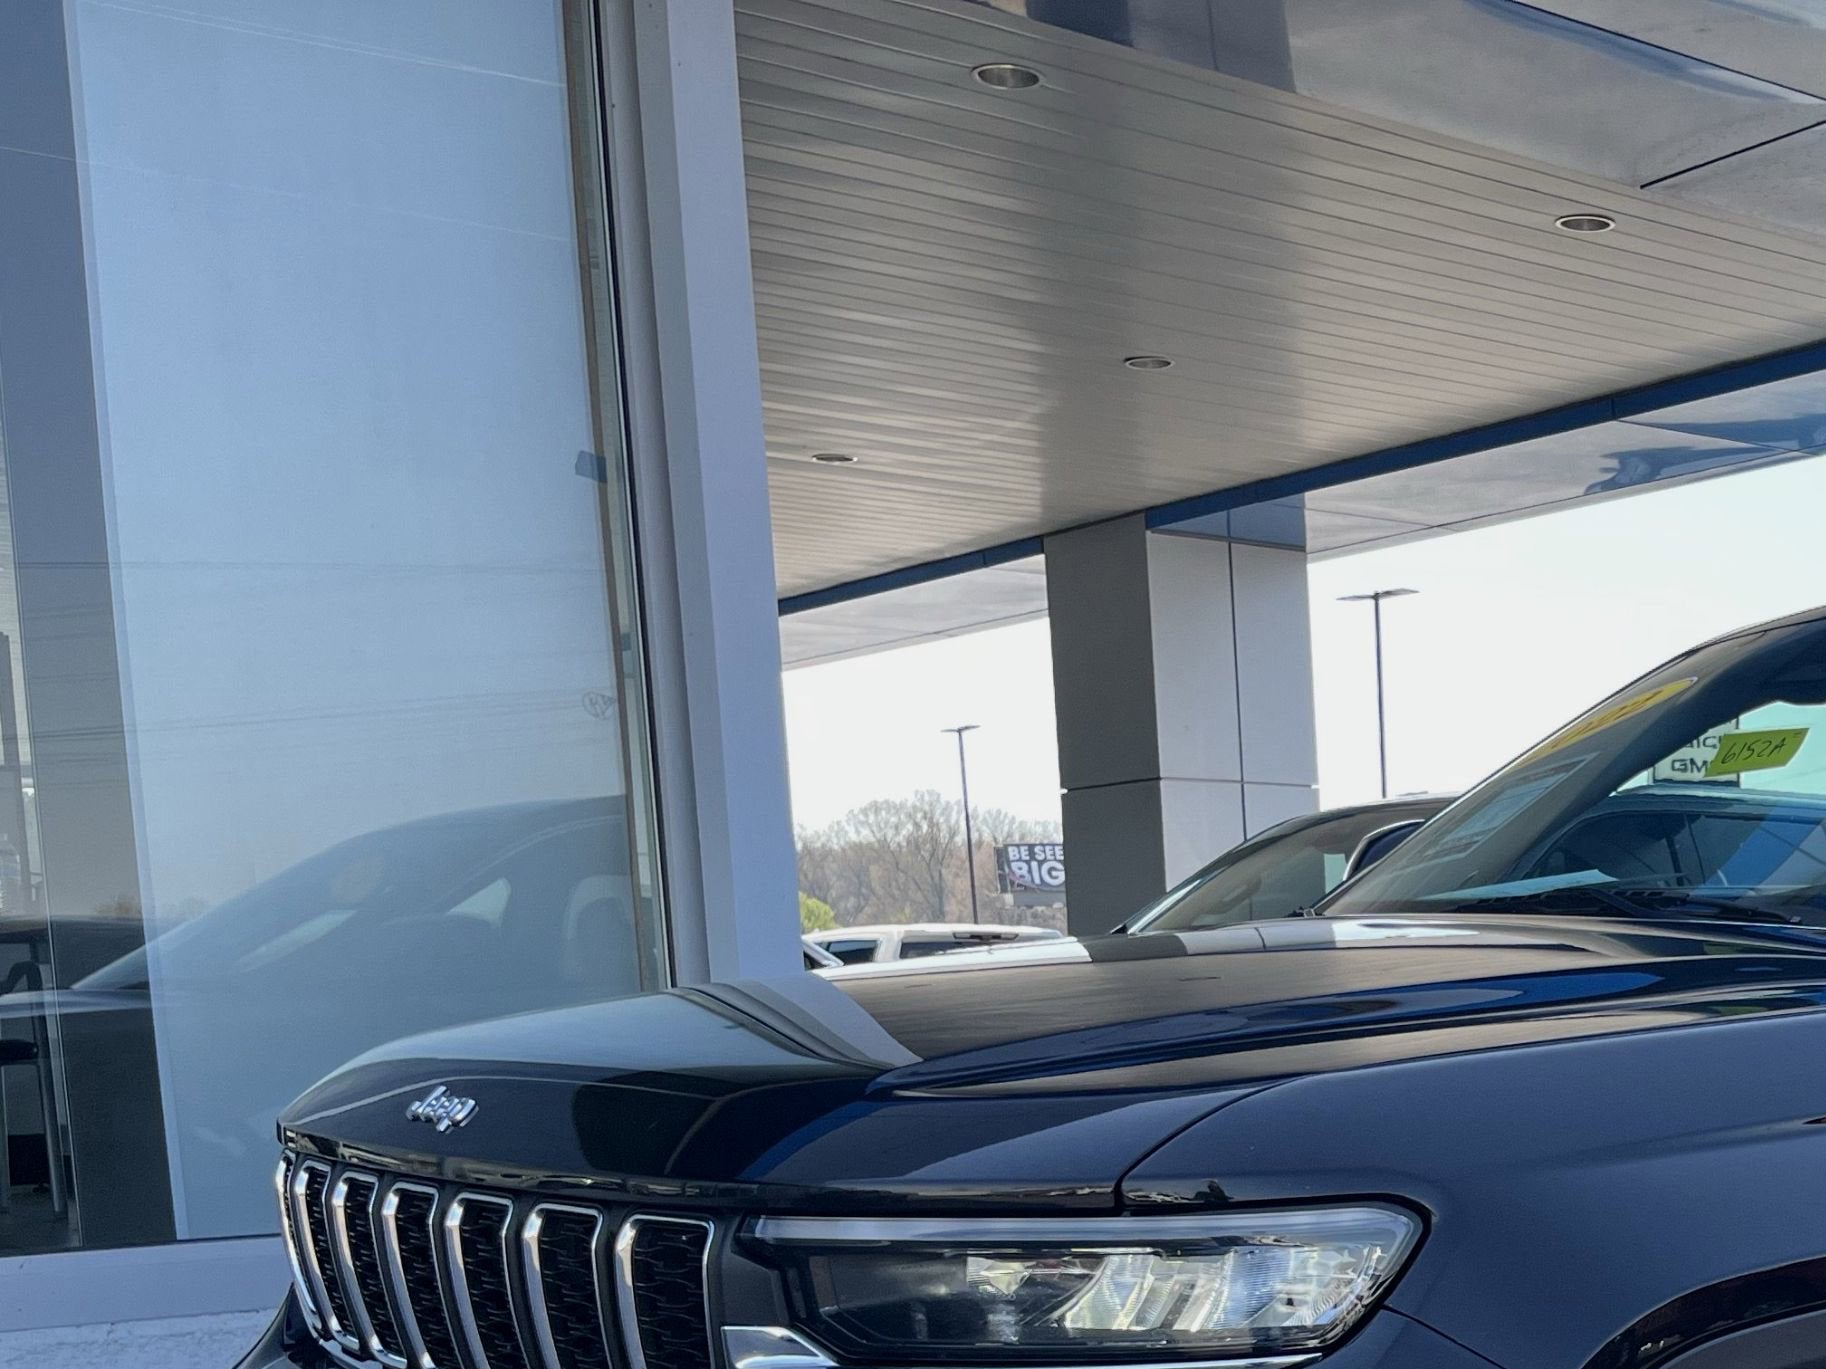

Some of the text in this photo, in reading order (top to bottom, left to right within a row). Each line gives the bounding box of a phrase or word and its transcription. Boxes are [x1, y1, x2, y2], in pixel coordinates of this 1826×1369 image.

[1721, 737, 1786, 764] 6152A
[1671, 757, 1710, 774] GM
[1008, 845, 1065, 861] BE SEE
[1011, 861, 1066, 886] BIG
[406, 1085, 478, 1132] Jeep
